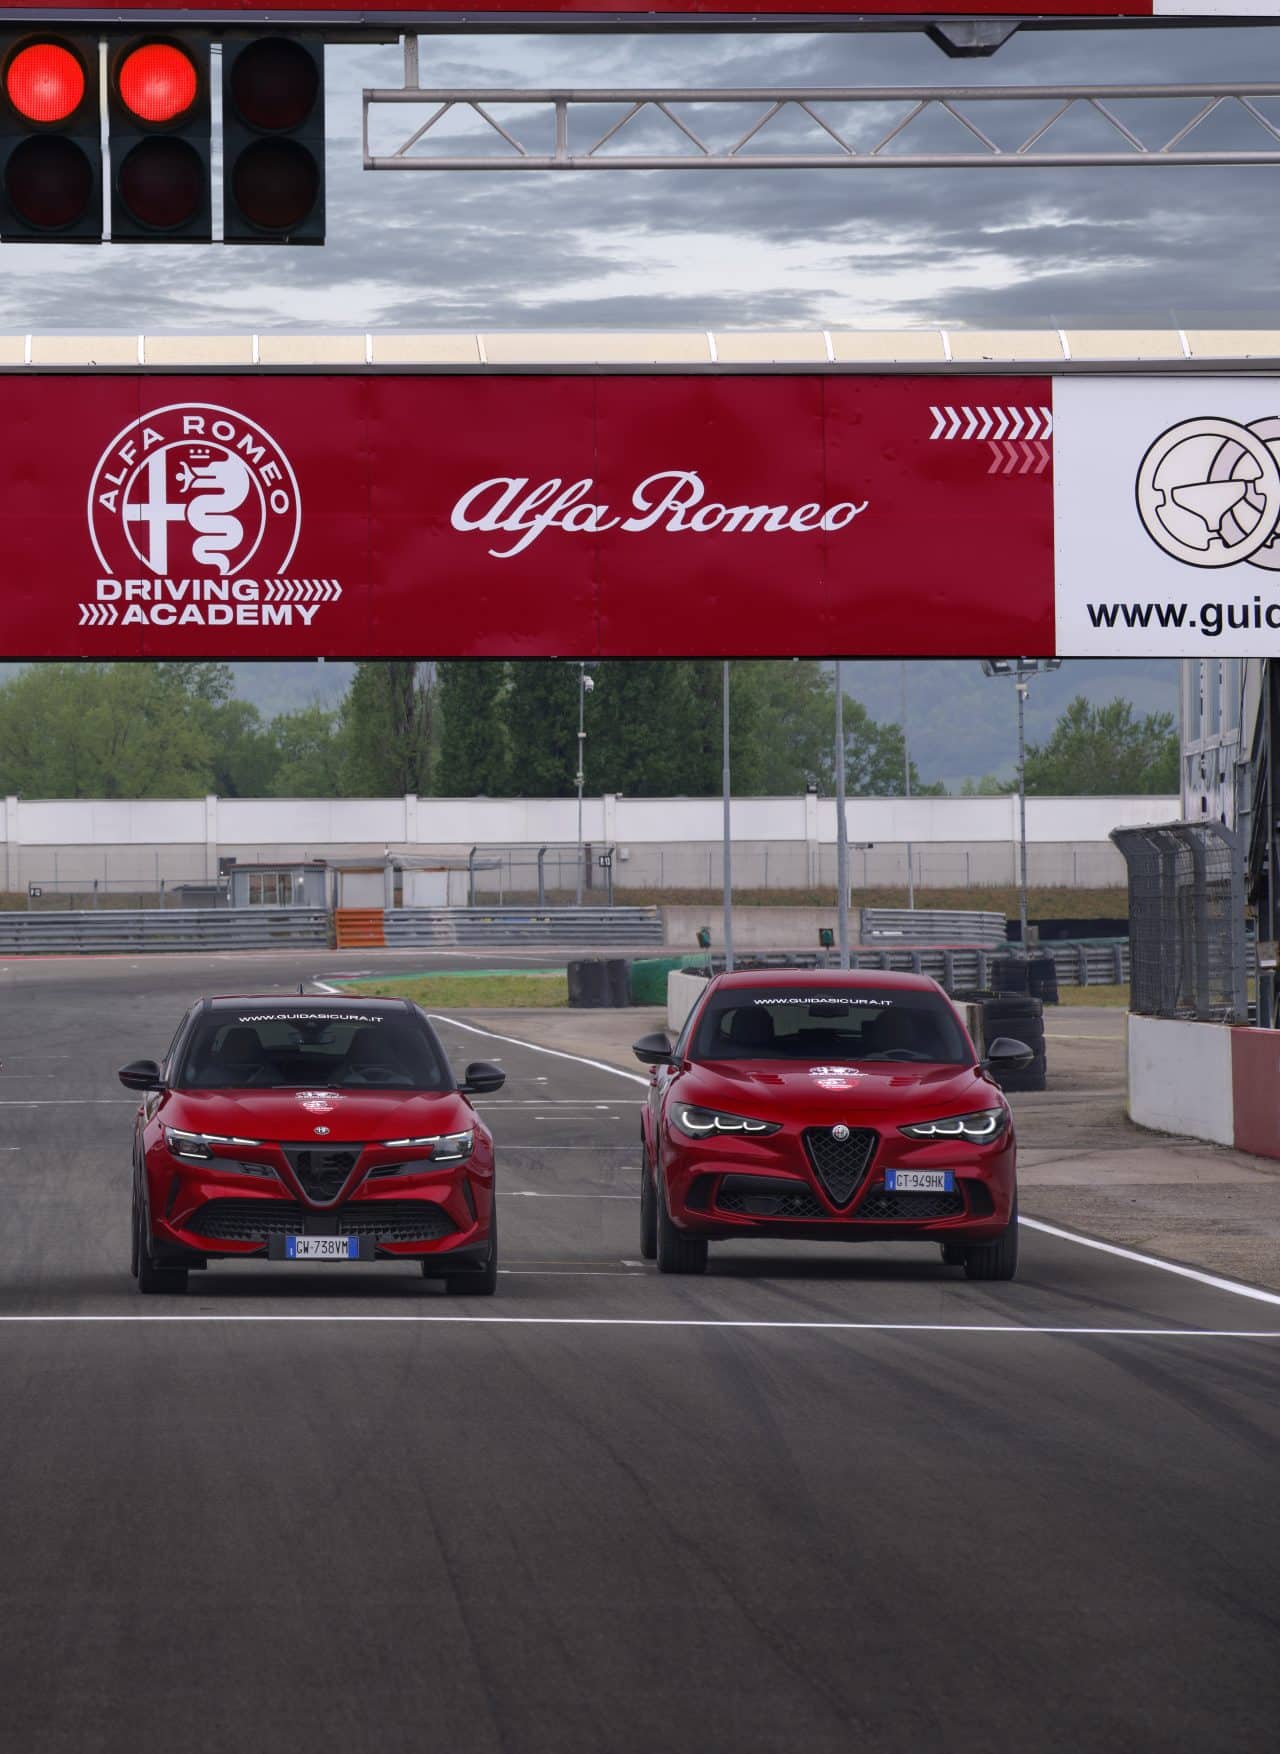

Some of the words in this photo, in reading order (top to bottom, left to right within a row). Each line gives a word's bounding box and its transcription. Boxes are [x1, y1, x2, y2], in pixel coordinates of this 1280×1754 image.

[99, 427, 165, 513] ALFA
[182, 415, 290, 514] ROMEO
[450, 477, 621, 559] Alfa
[620, 470, 869, 532] Romeo
[96, 579, 261, 601] DRIVING
[121, 604, 321, 626] ACADEMY
